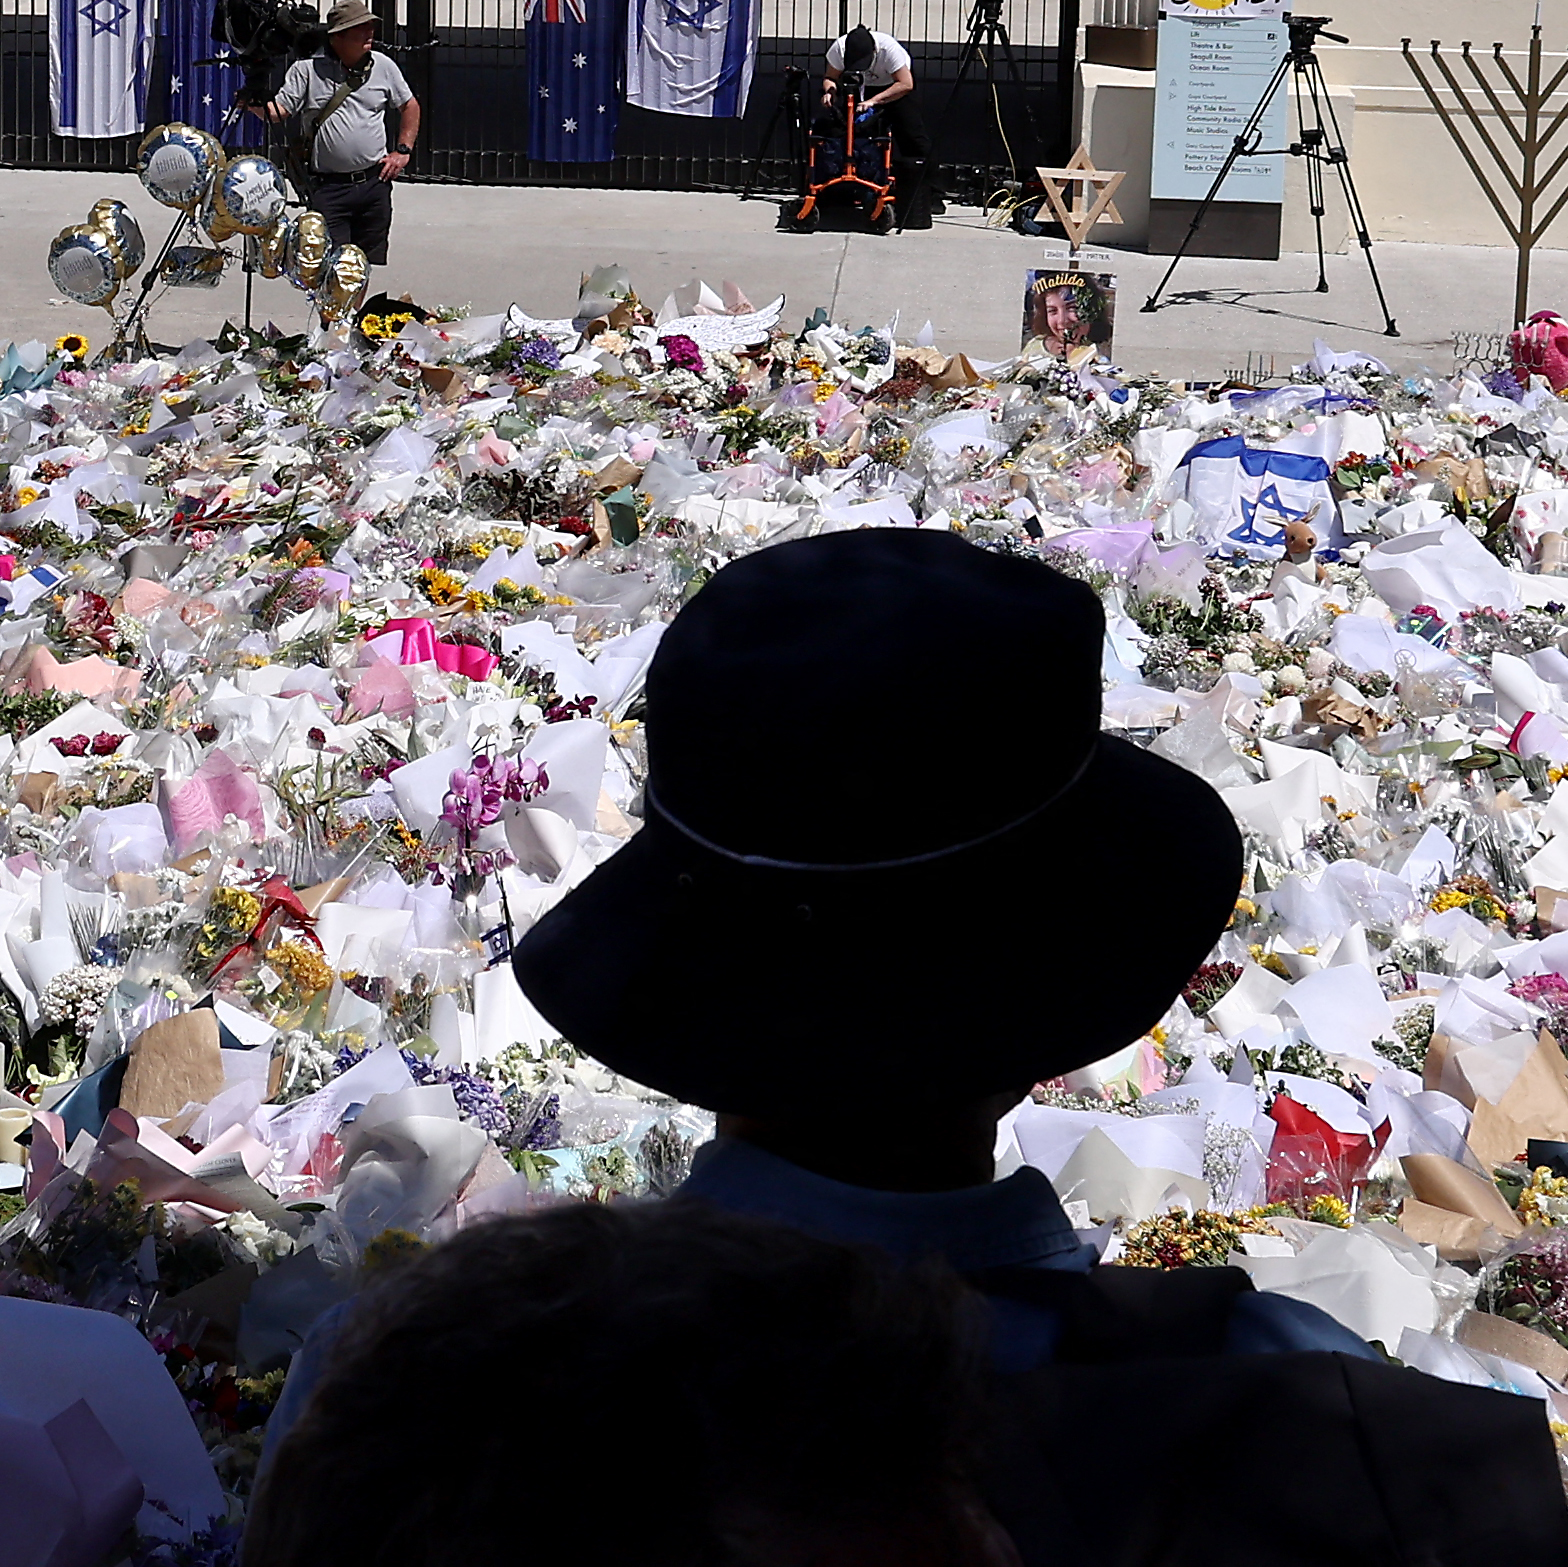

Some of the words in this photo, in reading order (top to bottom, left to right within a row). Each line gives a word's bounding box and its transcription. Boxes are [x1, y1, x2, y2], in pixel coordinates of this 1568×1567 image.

[1190, 53, 1213, 61] Seagull
[1187, 105, 1201, 113] High
[1186, 115, 1222, 123] Community
[1185, 154, 1208, 162] Pottery
[1032, 273, 1086, 295] Matilda
